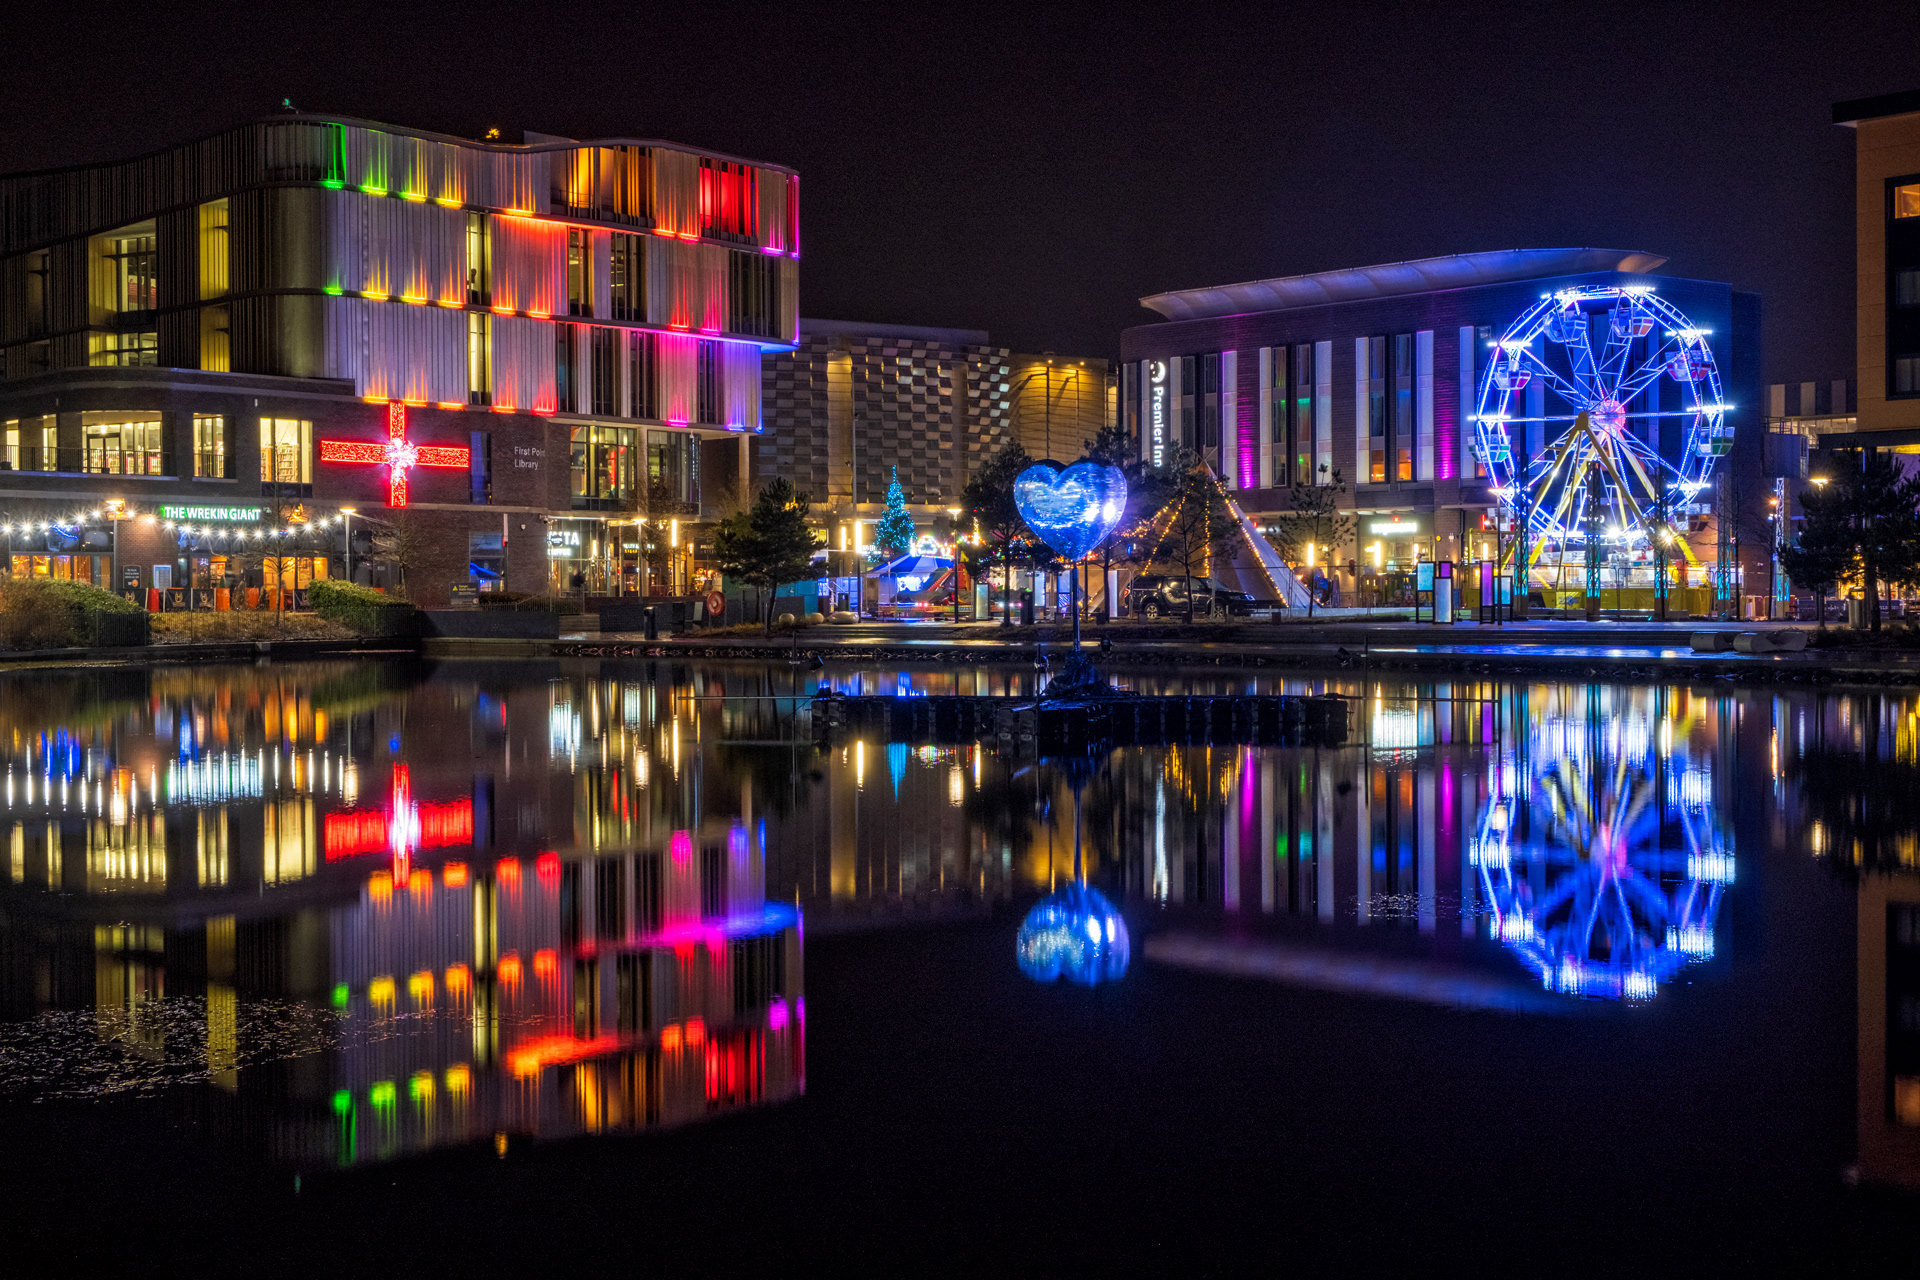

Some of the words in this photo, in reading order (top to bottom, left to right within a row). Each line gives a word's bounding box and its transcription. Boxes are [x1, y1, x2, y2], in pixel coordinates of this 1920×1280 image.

[1153, 386, 1164, 443] Premier
[514, 446, 530, 456] First
[1153, 445, 1164, 468] Inn
[514, 459, 539, 471] Library
[164, 506, 185, 519] THE
[187, 507, 227, 520] WREKIN
[229, 508, 261, 521] GIANT
